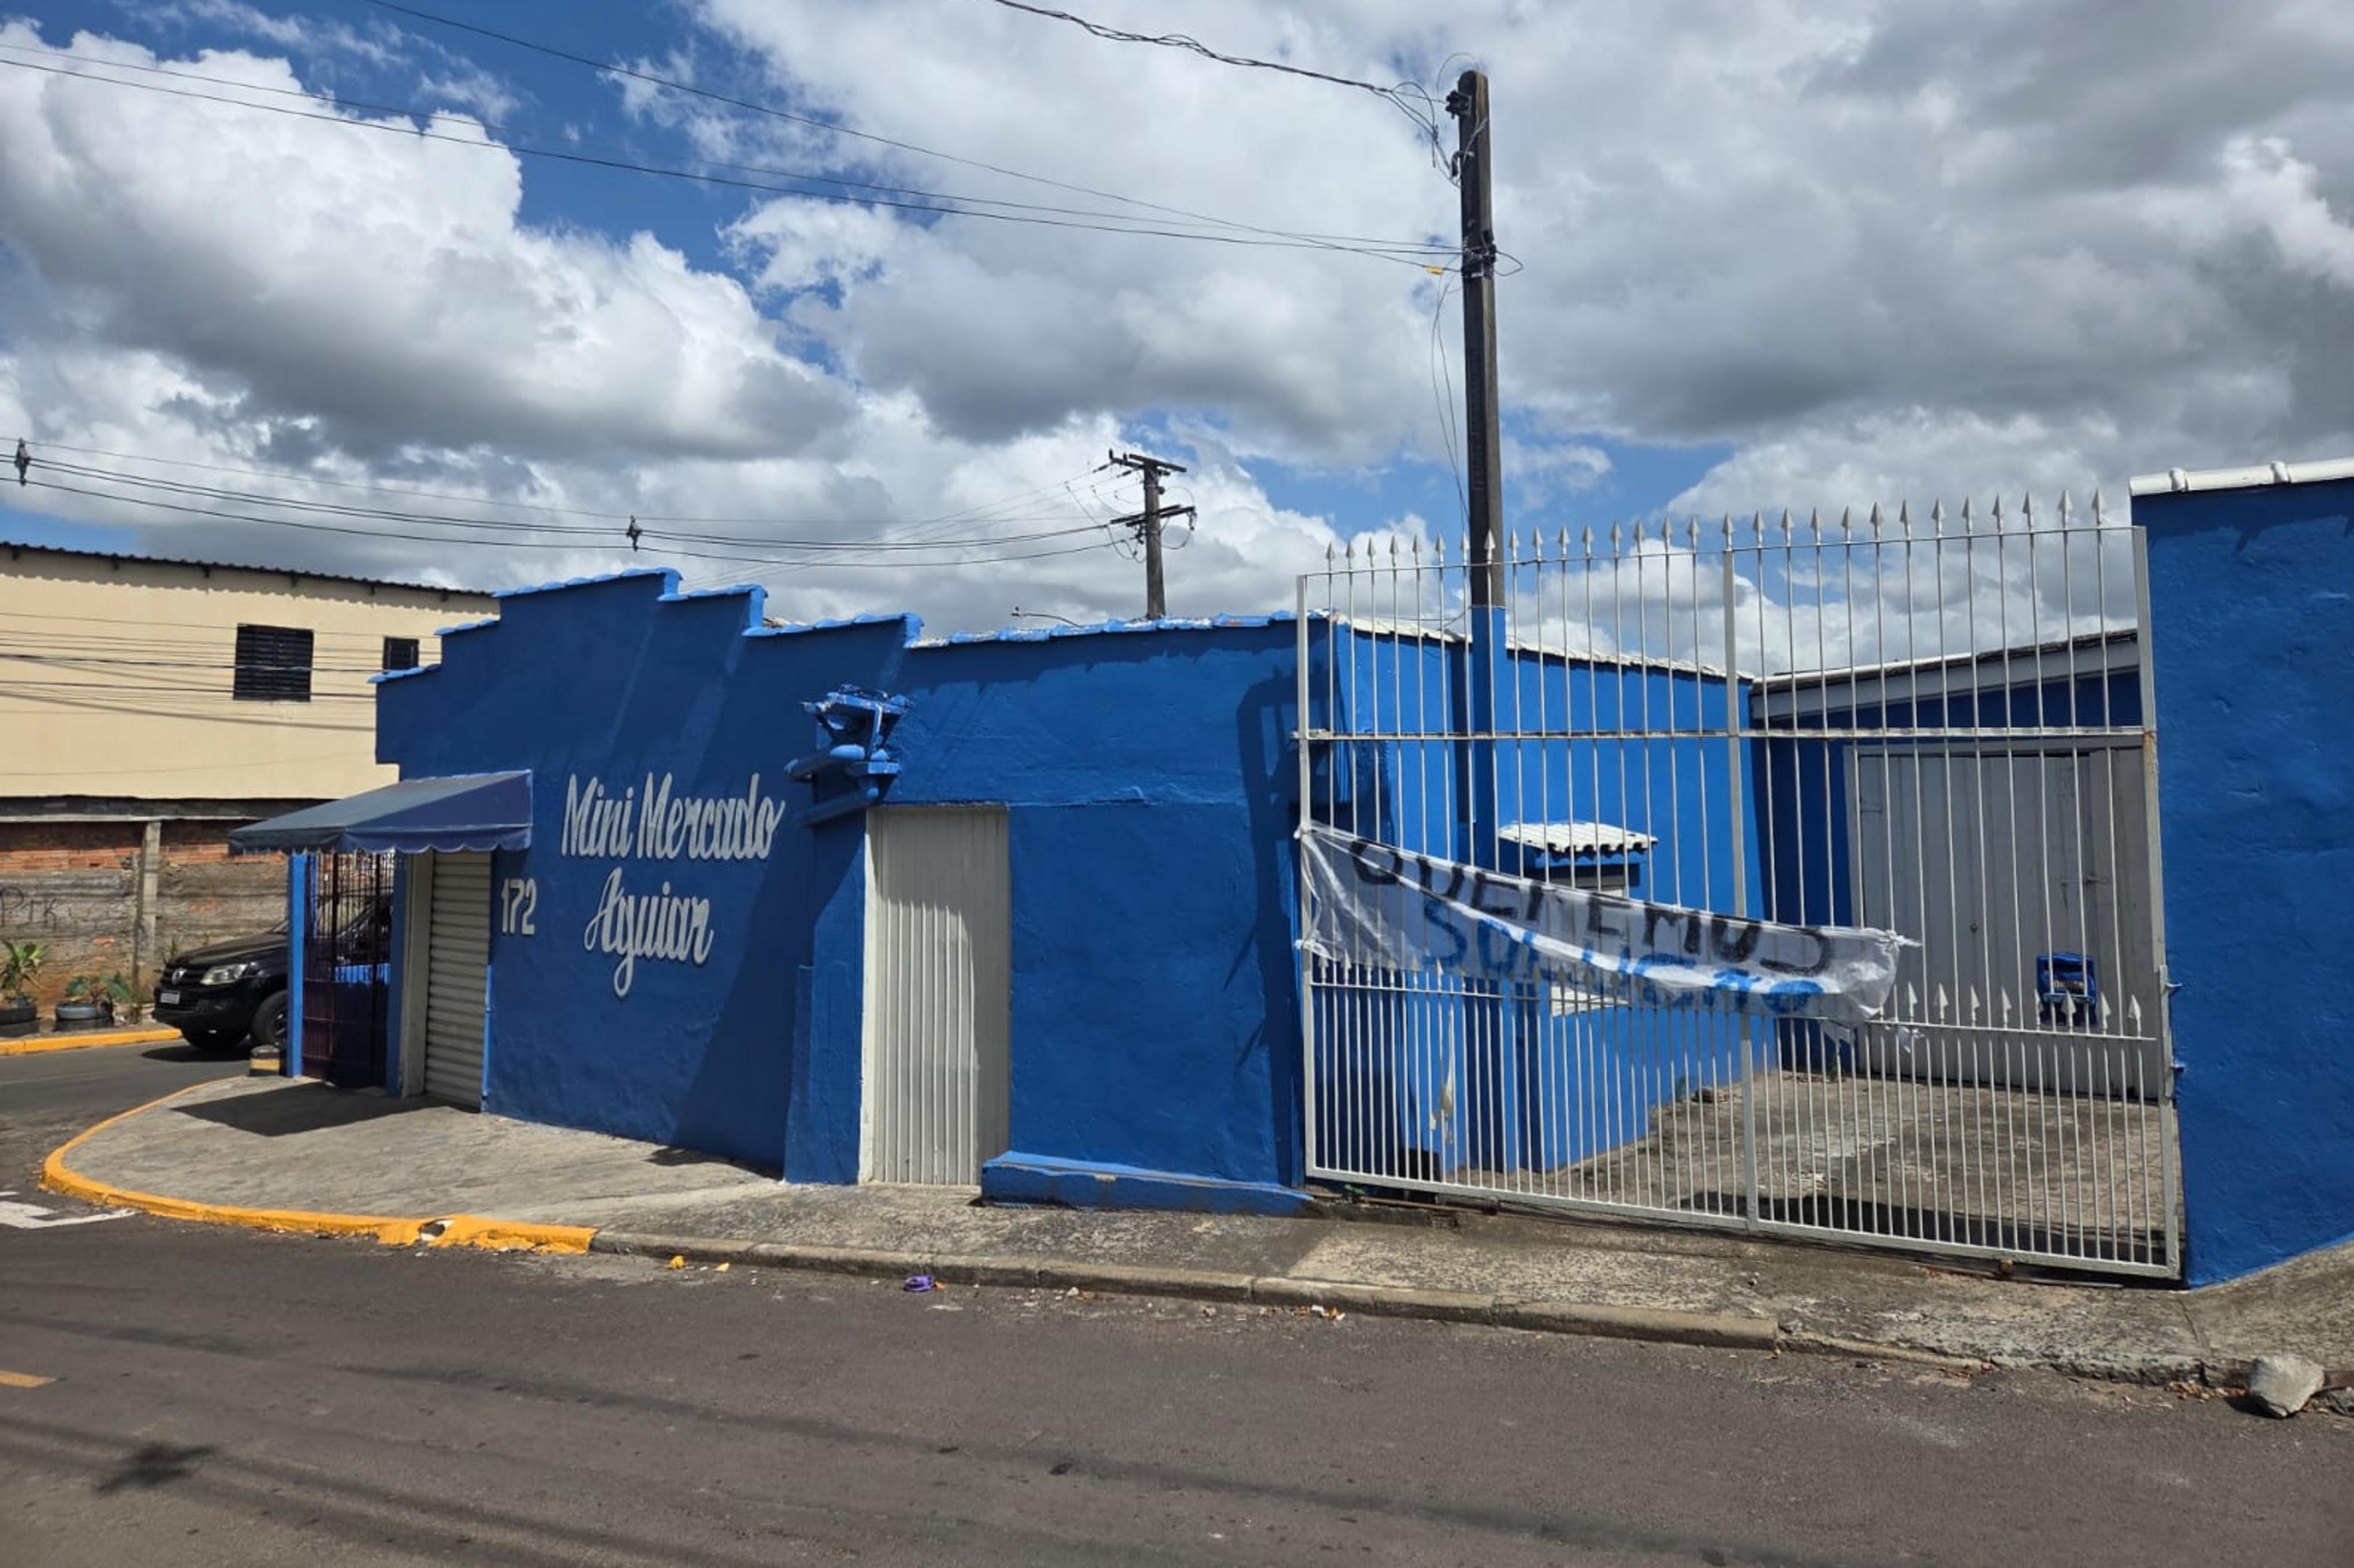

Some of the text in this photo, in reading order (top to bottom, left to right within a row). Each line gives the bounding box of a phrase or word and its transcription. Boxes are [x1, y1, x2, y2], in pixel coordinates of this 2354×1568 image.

[561, 772, 785, 860] Mini Mercado
[501, 878, 537, 936] 172
[584, 867, 714, 998] Aguiar
